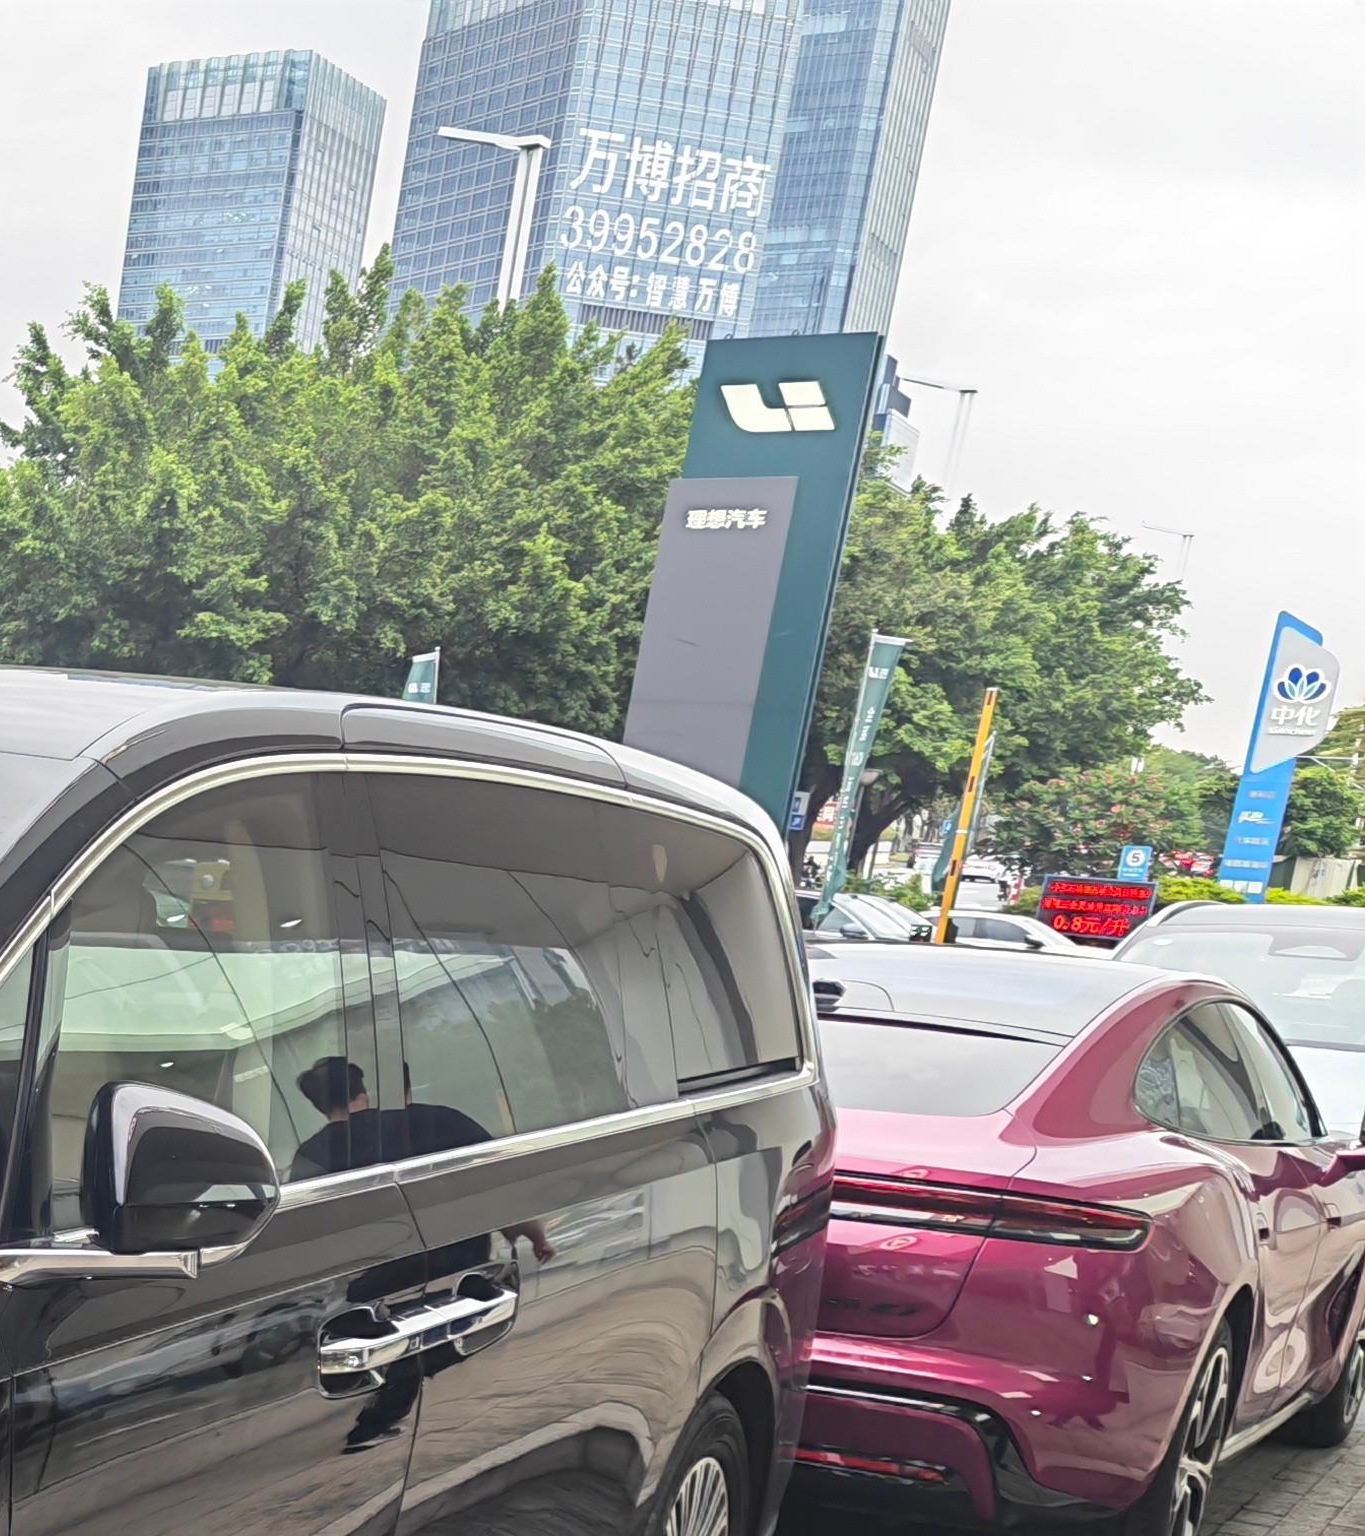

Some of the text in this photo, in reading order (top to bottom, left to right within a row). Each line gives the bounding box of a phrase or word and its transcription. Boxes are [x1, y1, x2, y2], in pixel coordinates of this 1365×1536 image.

[569, 127, 772, 218] 万博招商
[560, 205, 757, 274] 39952828
[685, 508, 768, 529] 理想汽车
[1271, 704, 1322, 727] 中化
[1130, 852, 1141, 864] 5
